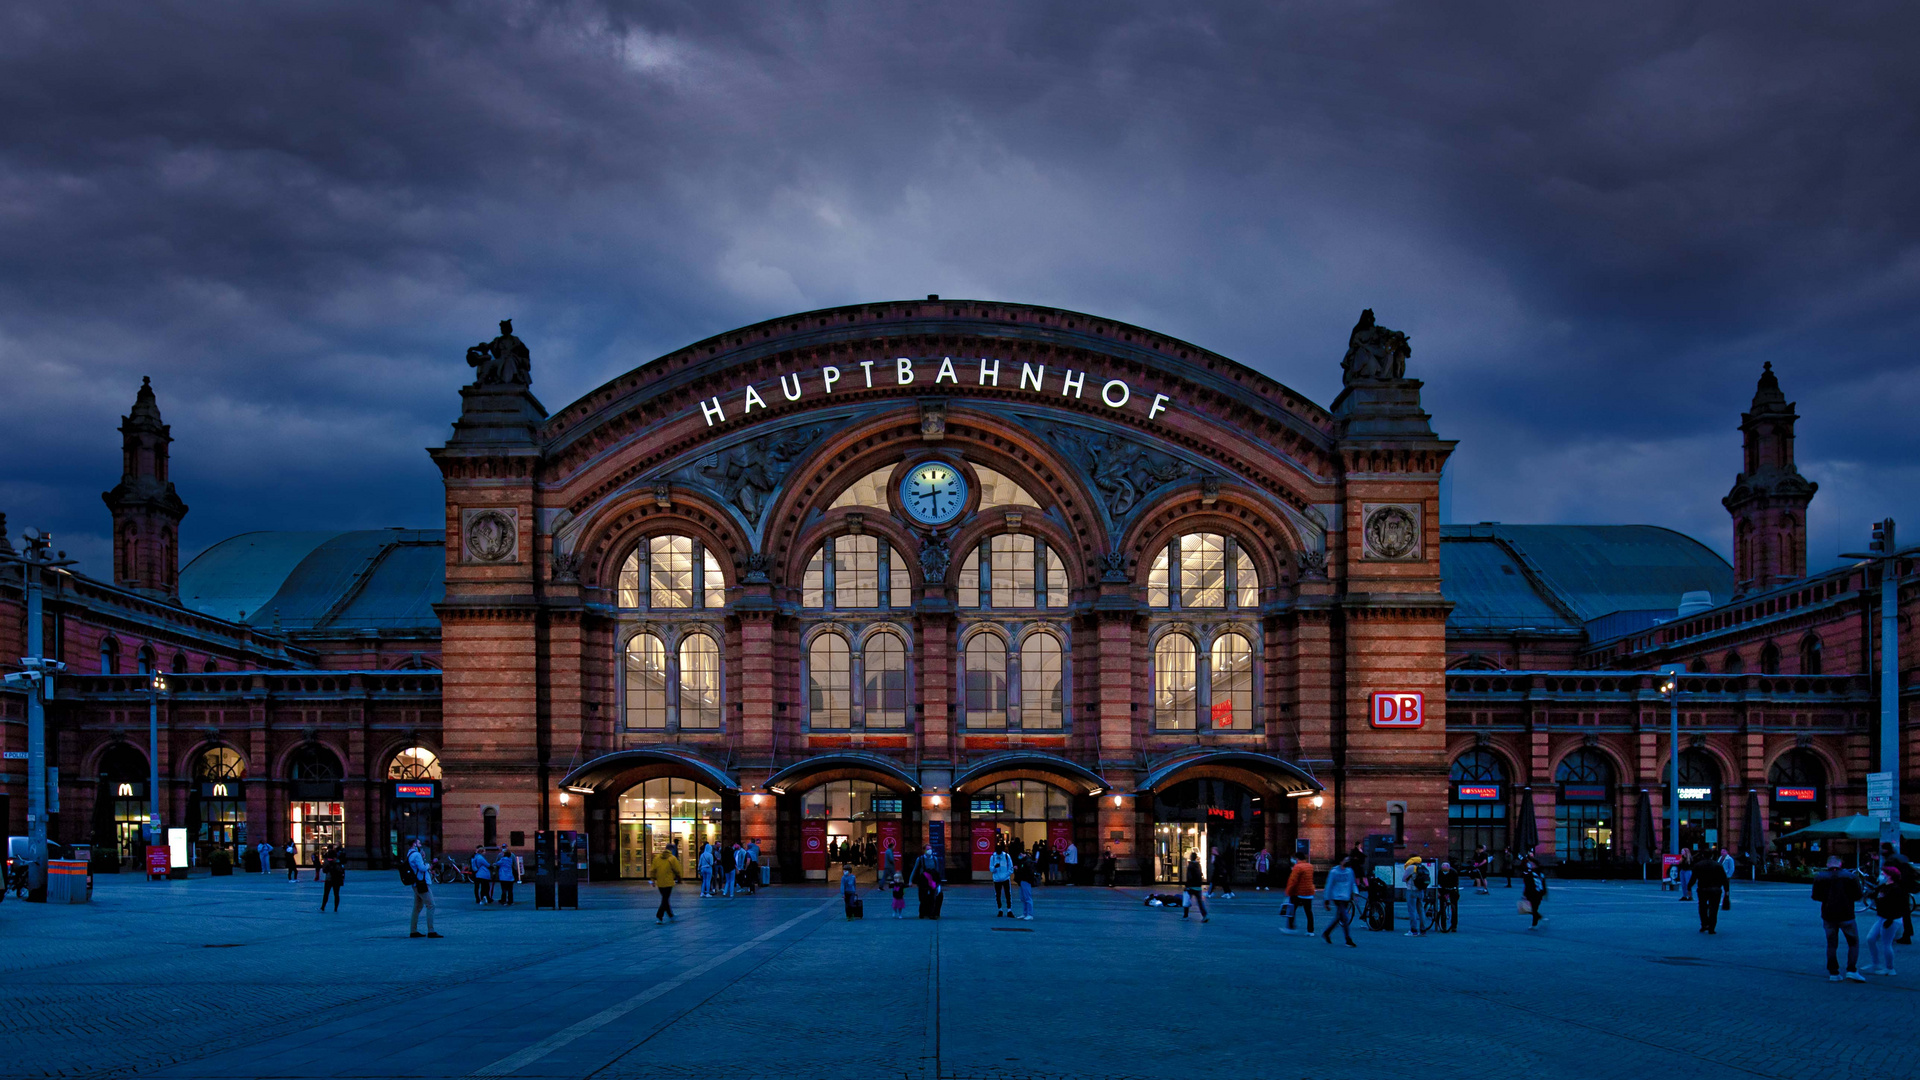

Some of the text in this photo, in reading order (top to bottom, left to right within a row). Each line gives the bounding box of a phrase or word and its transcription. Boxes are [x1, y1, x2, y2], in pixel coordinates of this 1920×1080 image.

[700, 357, 1170, 427] HAUPTBAHNHOF
[1379, 697, 1418, 721] DB
[1461, 787, 1496, 795] ROSSMANN
[1779, 789, 1814, 797] ROSSMANN
